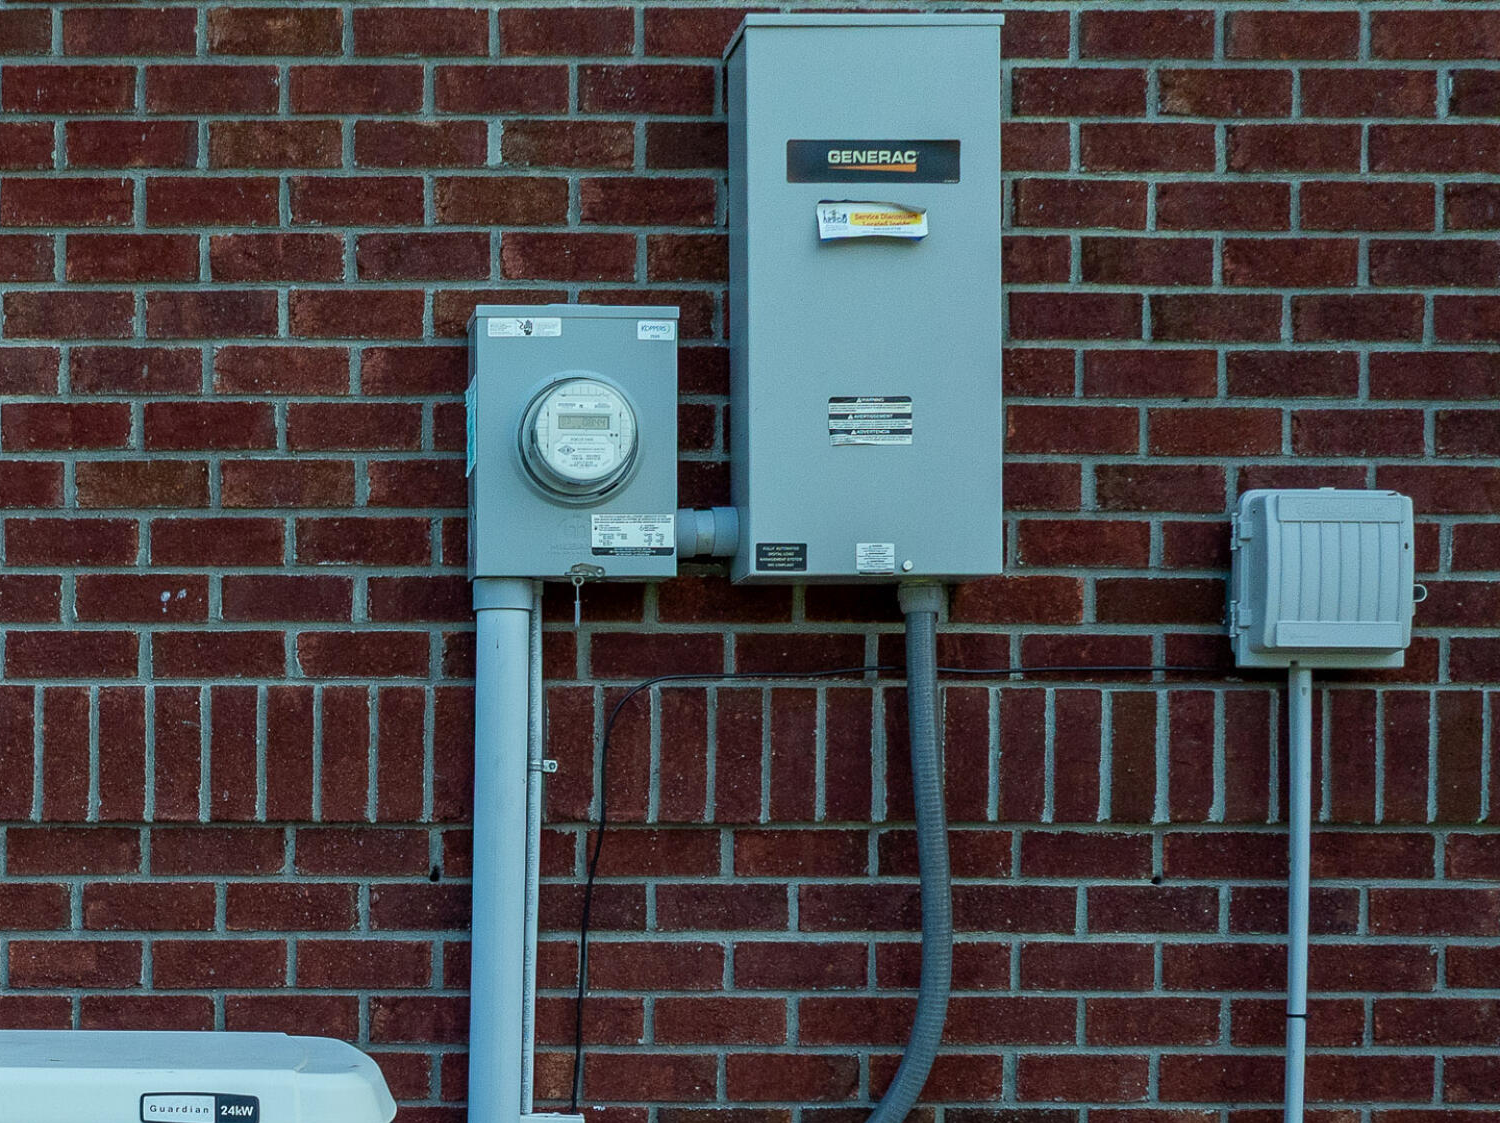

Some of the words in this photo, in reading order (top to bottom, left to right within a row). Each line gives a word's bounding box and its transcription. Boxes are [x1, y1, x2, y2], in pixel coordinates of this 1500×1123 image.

[827, 150, 917, 164] GENERAC
[149, 1104, 210, 1114] Guardian
[220, 1105, 254, 1116] 24kW
